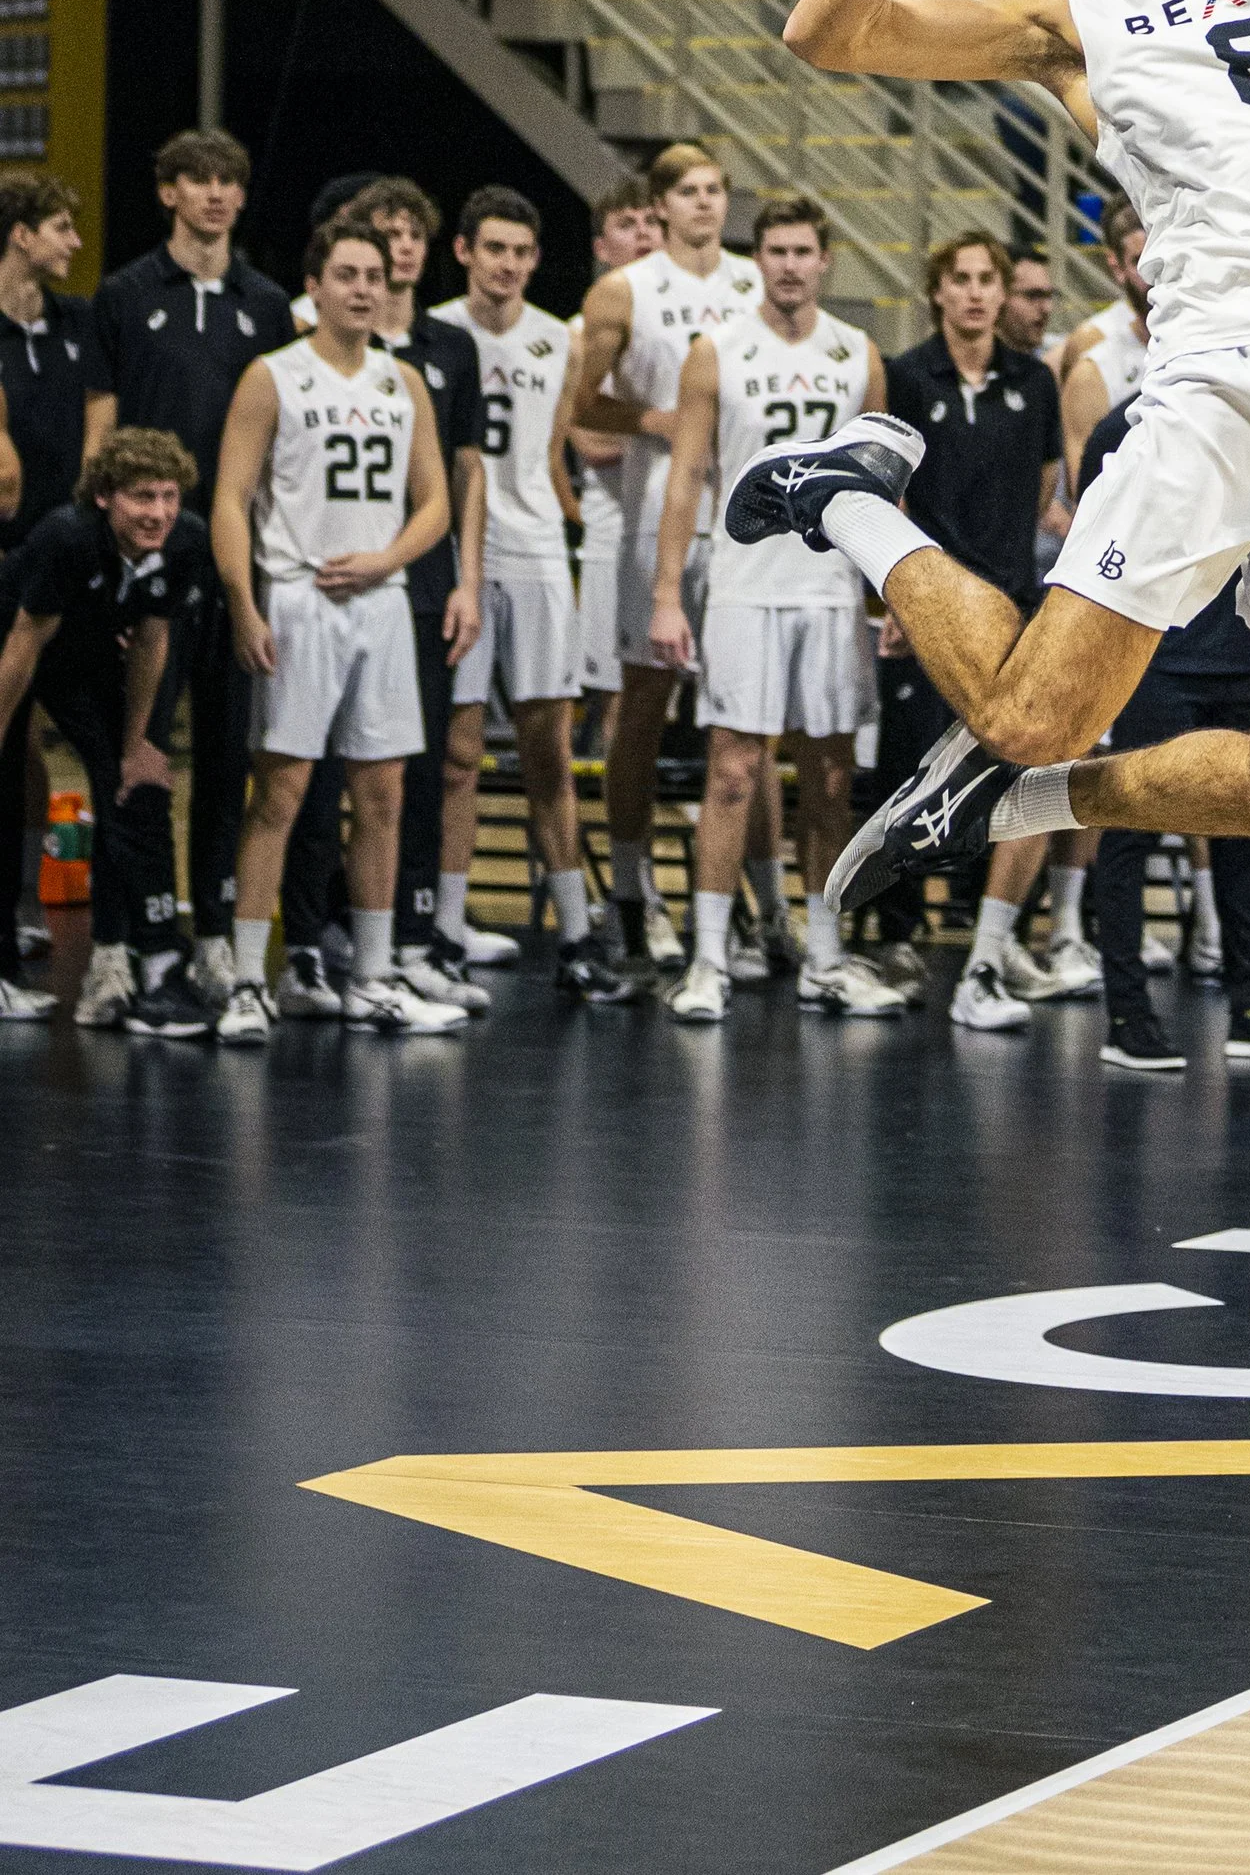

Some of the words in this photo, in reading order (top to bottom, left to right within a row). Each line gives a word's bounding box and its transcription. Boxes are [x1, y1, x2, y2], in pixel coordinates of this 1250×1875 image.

[744, 372, 851, 399] BEACH
[303, 404, 402, 431] BEACH
[763, 400, 838, 448] 27
[324, 432, 394, 502] 22
